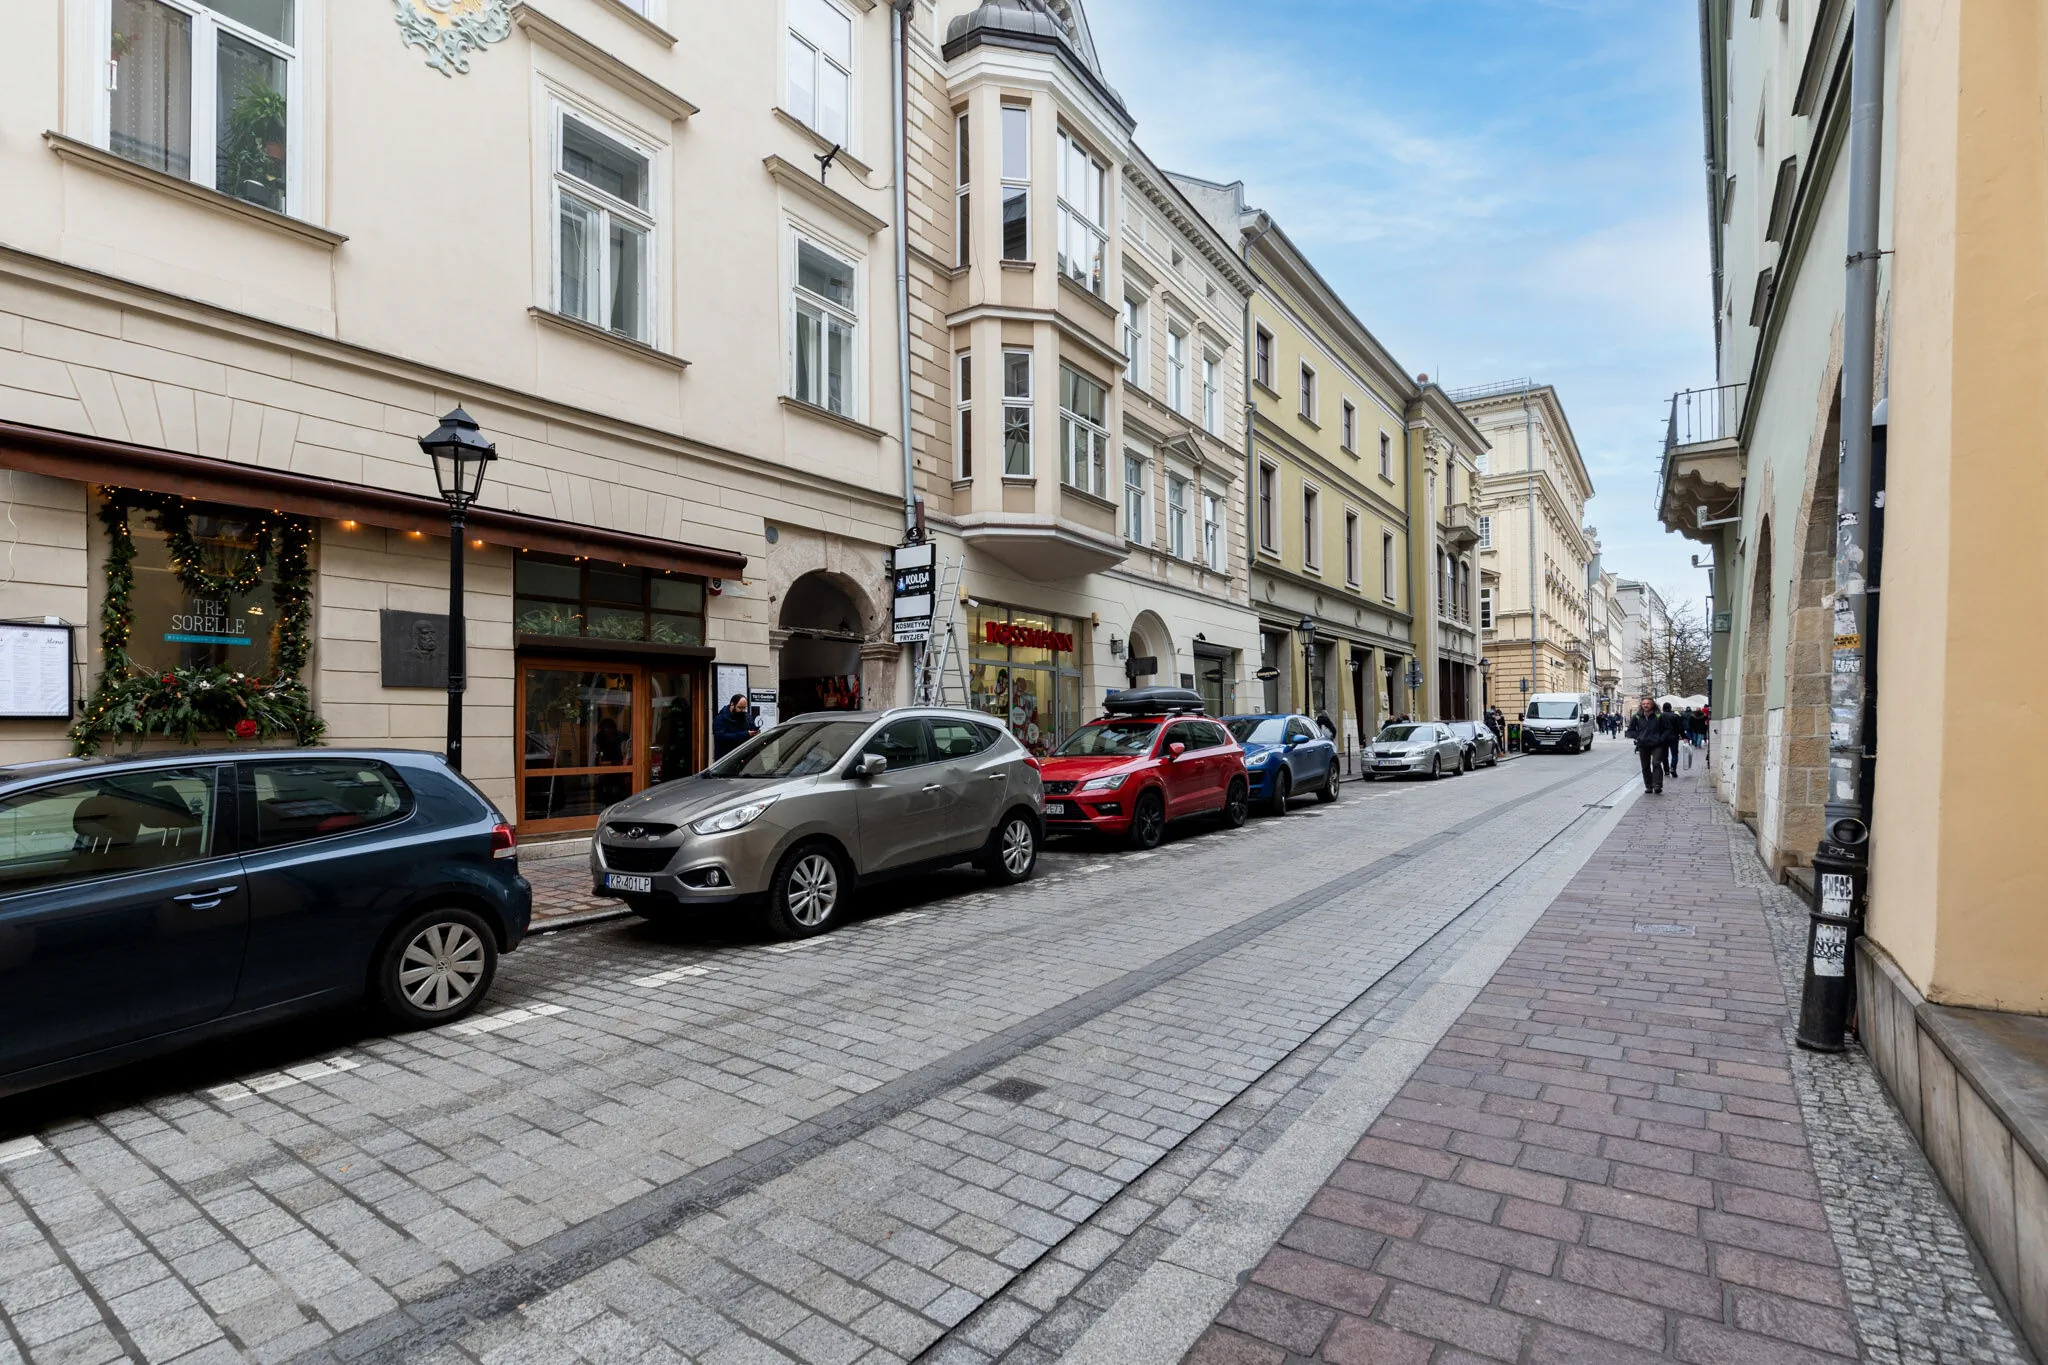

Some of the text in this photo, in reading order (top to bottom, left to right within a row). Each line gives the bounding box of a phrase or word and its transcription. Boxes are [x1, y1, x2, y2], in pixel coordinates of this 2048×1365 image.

[912, 528, 918, 537] 5
[905, 571, 930, 585] KOLBA
[193, 599, 225, 616] TRE
[171, 614, 245, 634] SORELLE
[895, 620, 930, 630] KOSMETYKA
[900, 632, 924, 642] FRYZJER
[985, 621, 1073, 652] ROSSMANN
